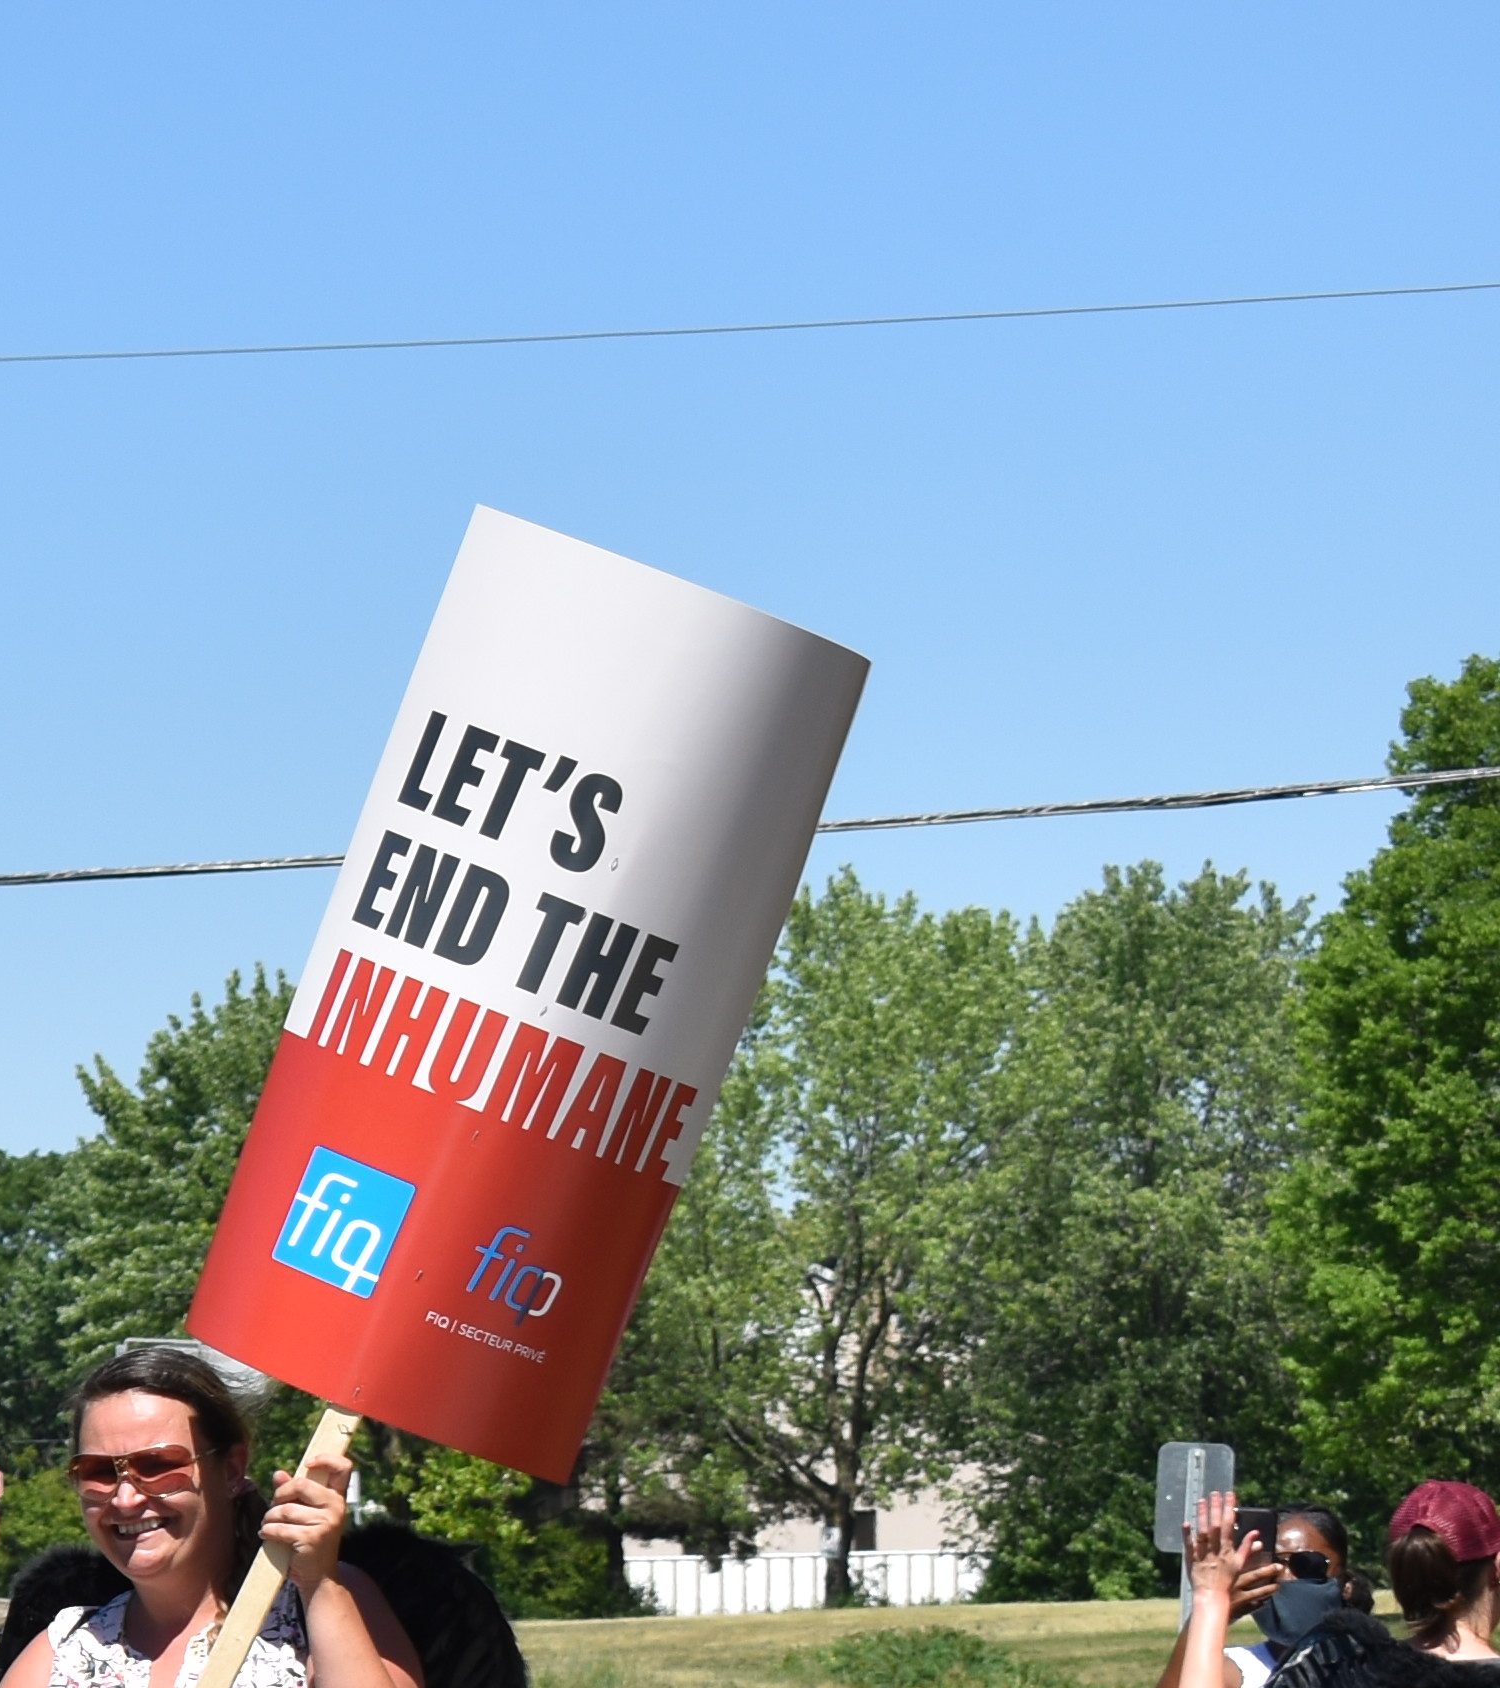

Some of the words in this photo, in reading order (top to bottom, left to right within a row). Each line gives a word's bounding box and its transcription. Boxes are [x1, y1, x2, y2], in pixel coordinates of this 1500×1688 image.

[398, 711, 624, 873] LET'S
[352, 830, 510, 966] END
[516, 894, 680, 1035] THE
[308, 949, 698, 1178] INHUMANE
[425, 1311, 450, 1329] FIQ
[458, 1323, 513, 1352] SECTEUR
[513, 1343, 546, 1363] PRIVÉ
